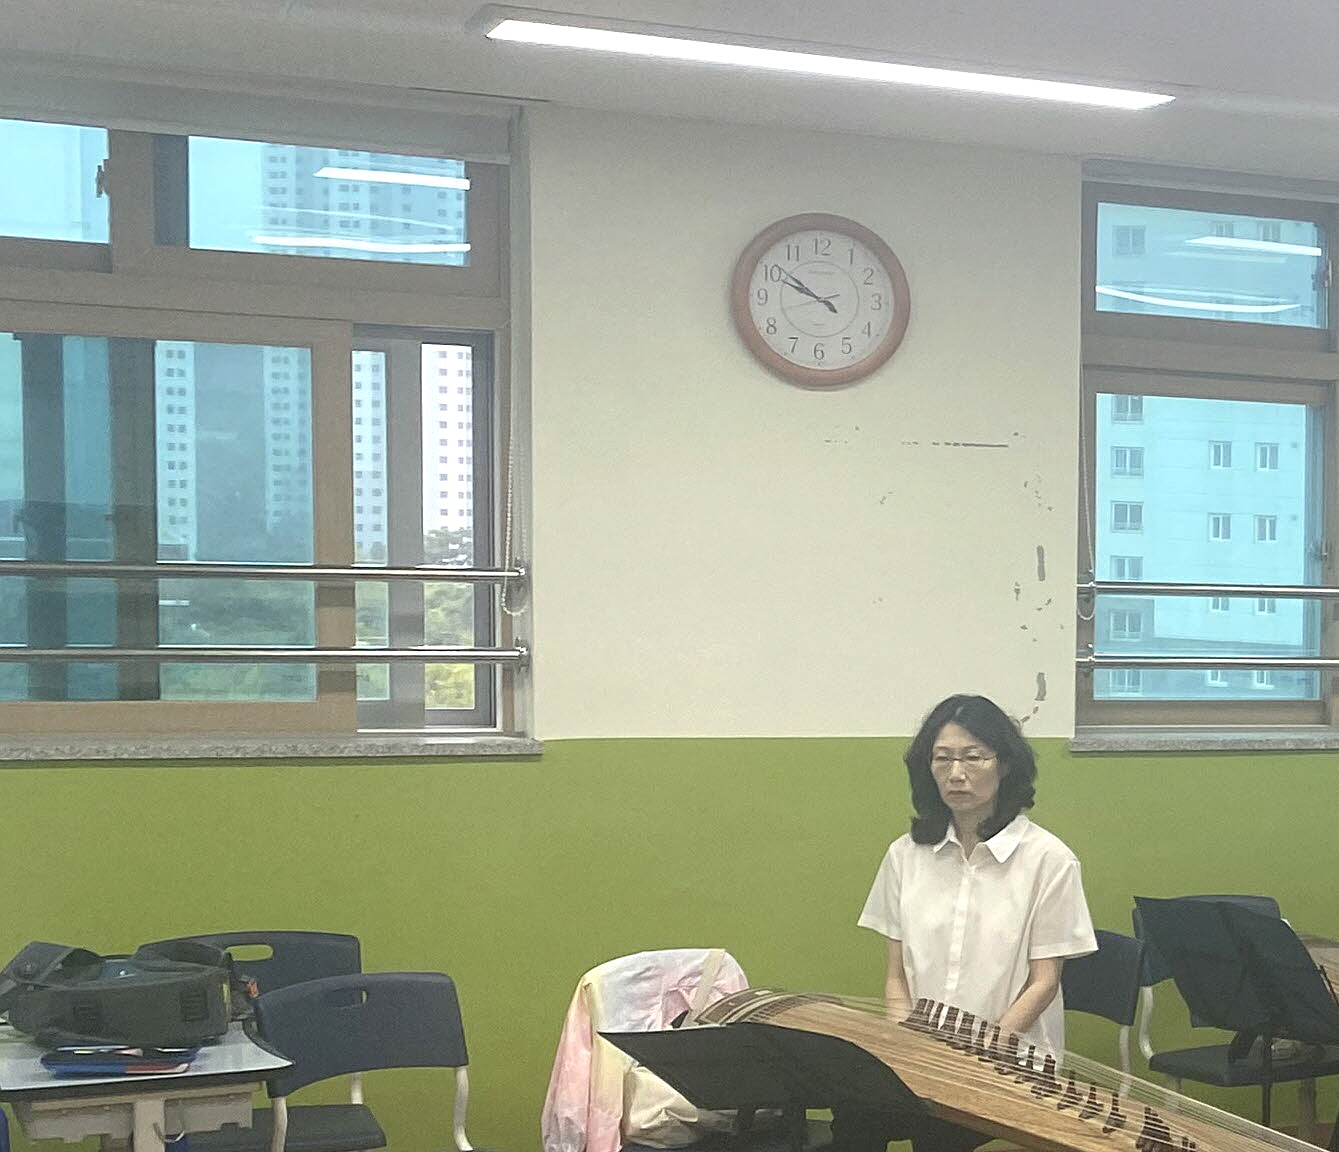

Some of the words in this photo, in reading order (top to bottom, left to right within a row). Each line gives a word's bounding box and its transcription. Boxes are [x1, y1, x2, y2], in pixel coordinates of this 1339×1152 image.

[785, 244, 800, 262] 11
[813, 238, 832, 256] 12
[848, 248, 855, 266] 1
[763, 264, 782, 283] 10
[863, 268, 875, 285] 2
[756, 289, 769, 306] 9
[871, 294, 883, 311] 3
[766, 317, 777, 335] 8
[862, 321, 872, 338] 4
[788, 337, 799, 354] 7
[813, 342, 825, 361] 6
[841, 337, 852, 355] 5
